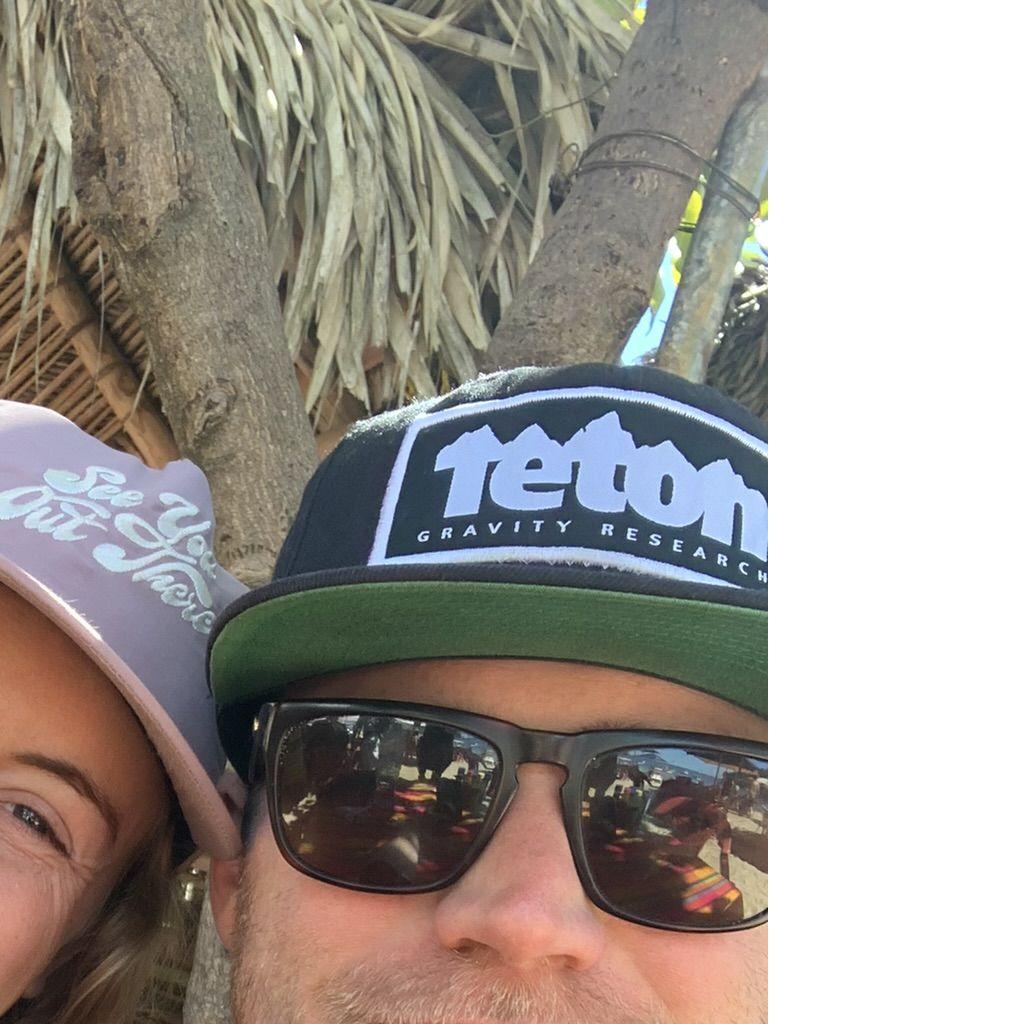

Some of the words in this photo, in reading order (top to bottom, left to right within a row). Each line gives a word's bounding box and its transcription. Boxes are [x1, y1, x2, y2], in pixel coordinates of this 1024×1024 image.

[43, 466, 144, 507] See
[114, 492, 216, 579] You
[417, 519, 572, 543] GRAVITY
[601, 522, 767, 583] RESEARCH
[92, 543, 216, 634] There
